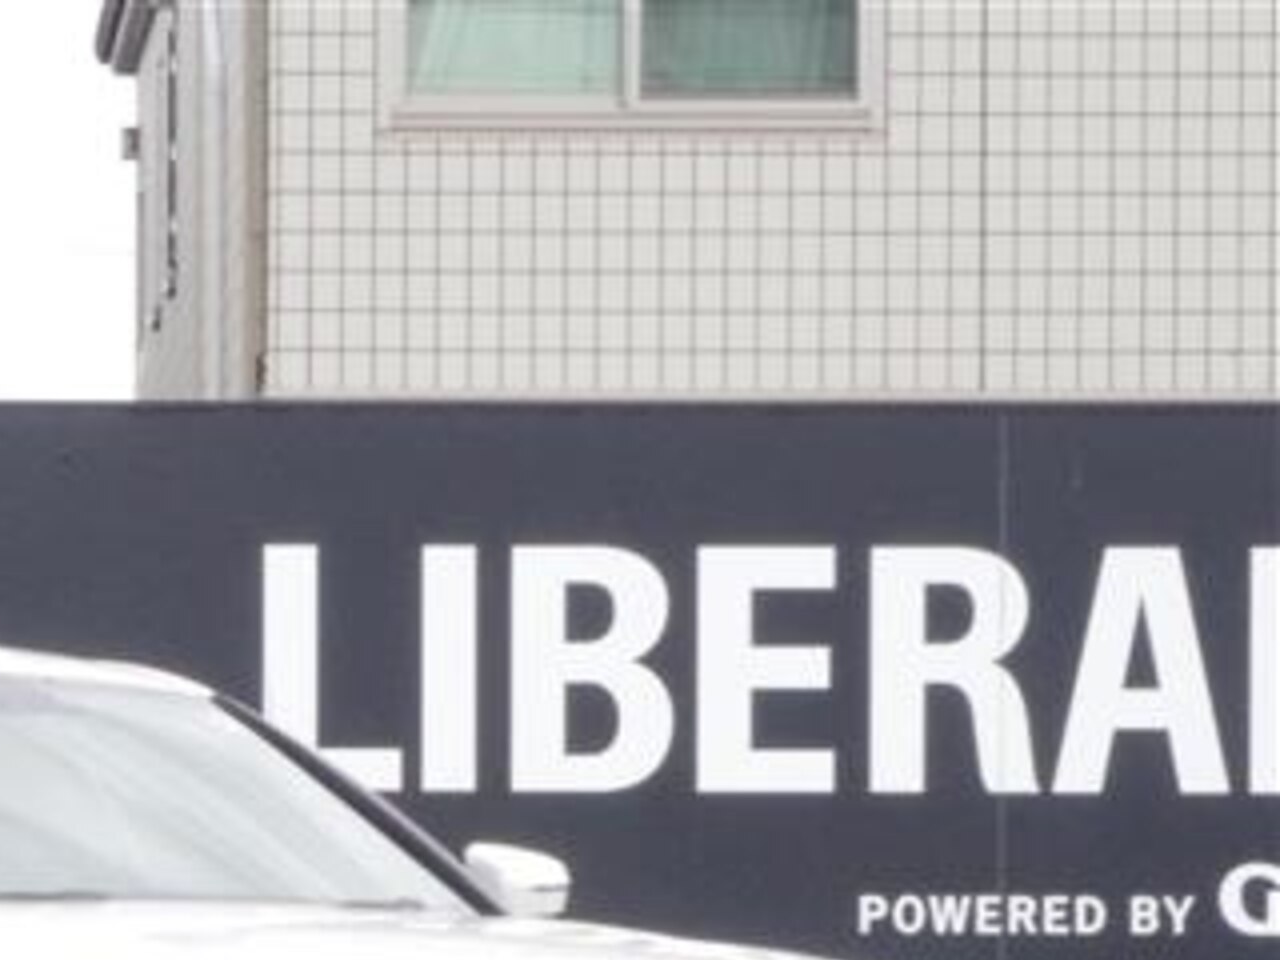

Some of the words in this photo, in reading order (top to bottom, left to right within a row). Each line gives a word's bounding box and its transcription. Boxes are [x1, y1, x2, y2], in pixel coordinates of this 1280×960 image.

[262, 543, 1280, 795] LIBERA
[858, 894, 1107, 935] POWERED
[1130, 894, 1194, 935] BY
